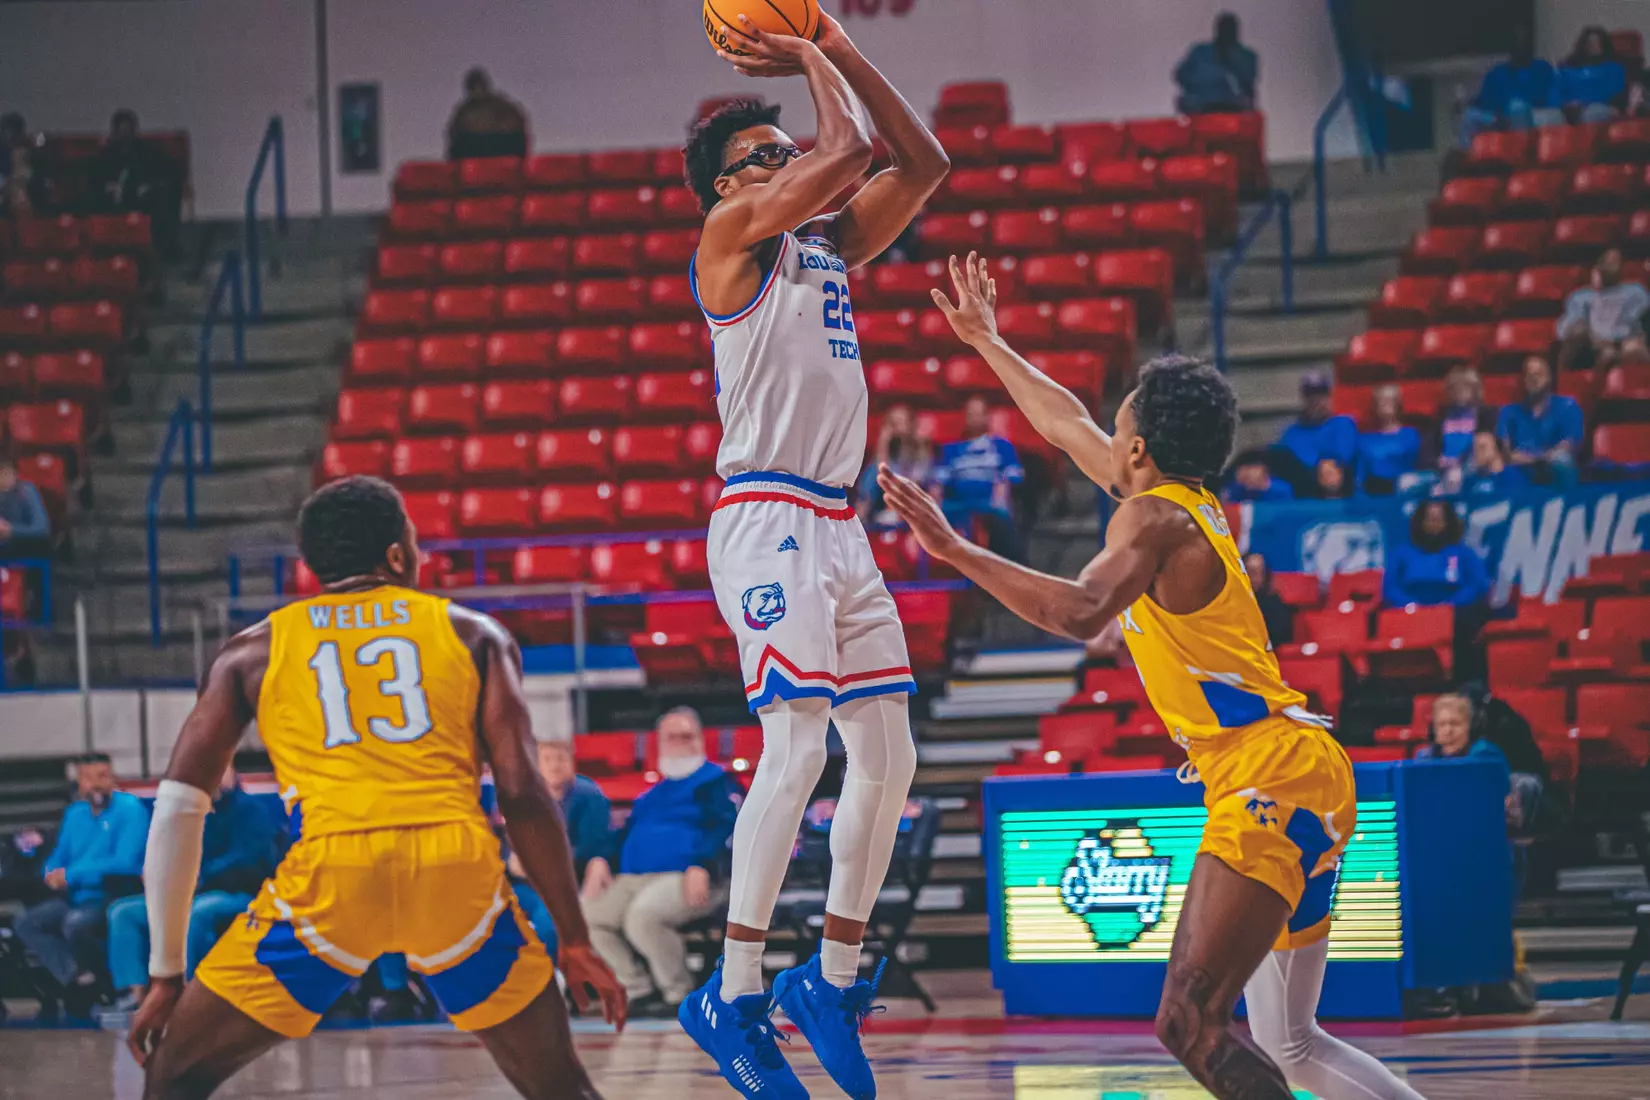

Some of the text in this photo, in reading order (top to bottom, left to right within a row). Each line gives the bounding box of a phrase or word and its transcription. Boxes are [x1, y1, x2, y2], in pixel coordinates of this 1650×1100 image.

[704, 9, 757, 57] Wilso
[822, 280, 854, 332] 22
[828, 338, 860, 360] TECH
[308, 600, 411, 630] WELLS
[308, 636, 433, 750] 13
